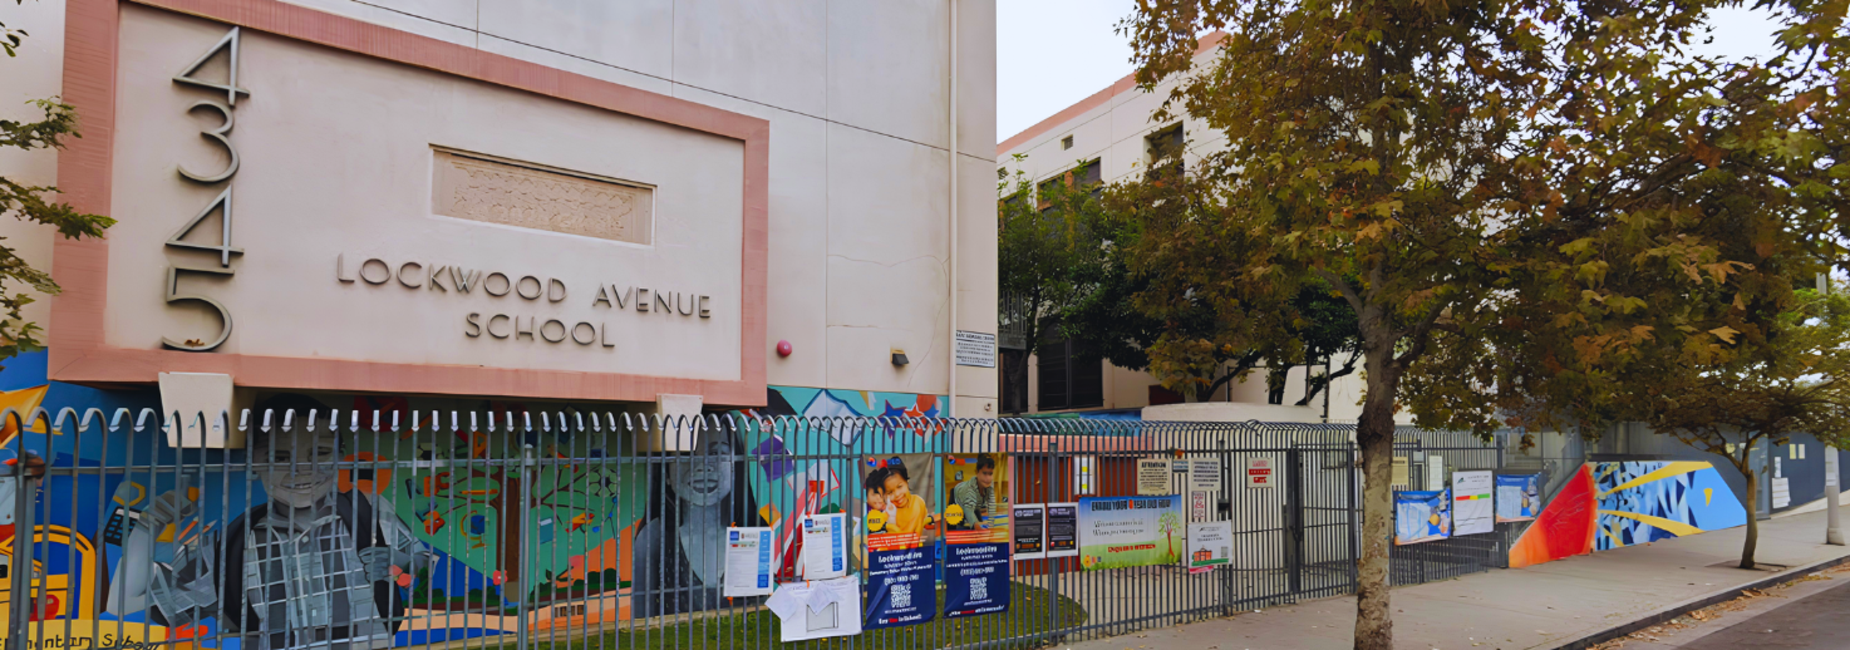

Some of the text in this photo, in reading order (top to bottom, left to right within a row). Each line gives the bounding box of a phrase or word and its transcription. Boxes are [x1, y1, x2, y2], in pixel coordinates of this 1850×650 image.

[161, 25, 250, 352] 4345
[336, 252, 711, 319] LOCKWOOD AVENUE
[465, 312, 616, 348] SCHOOL
